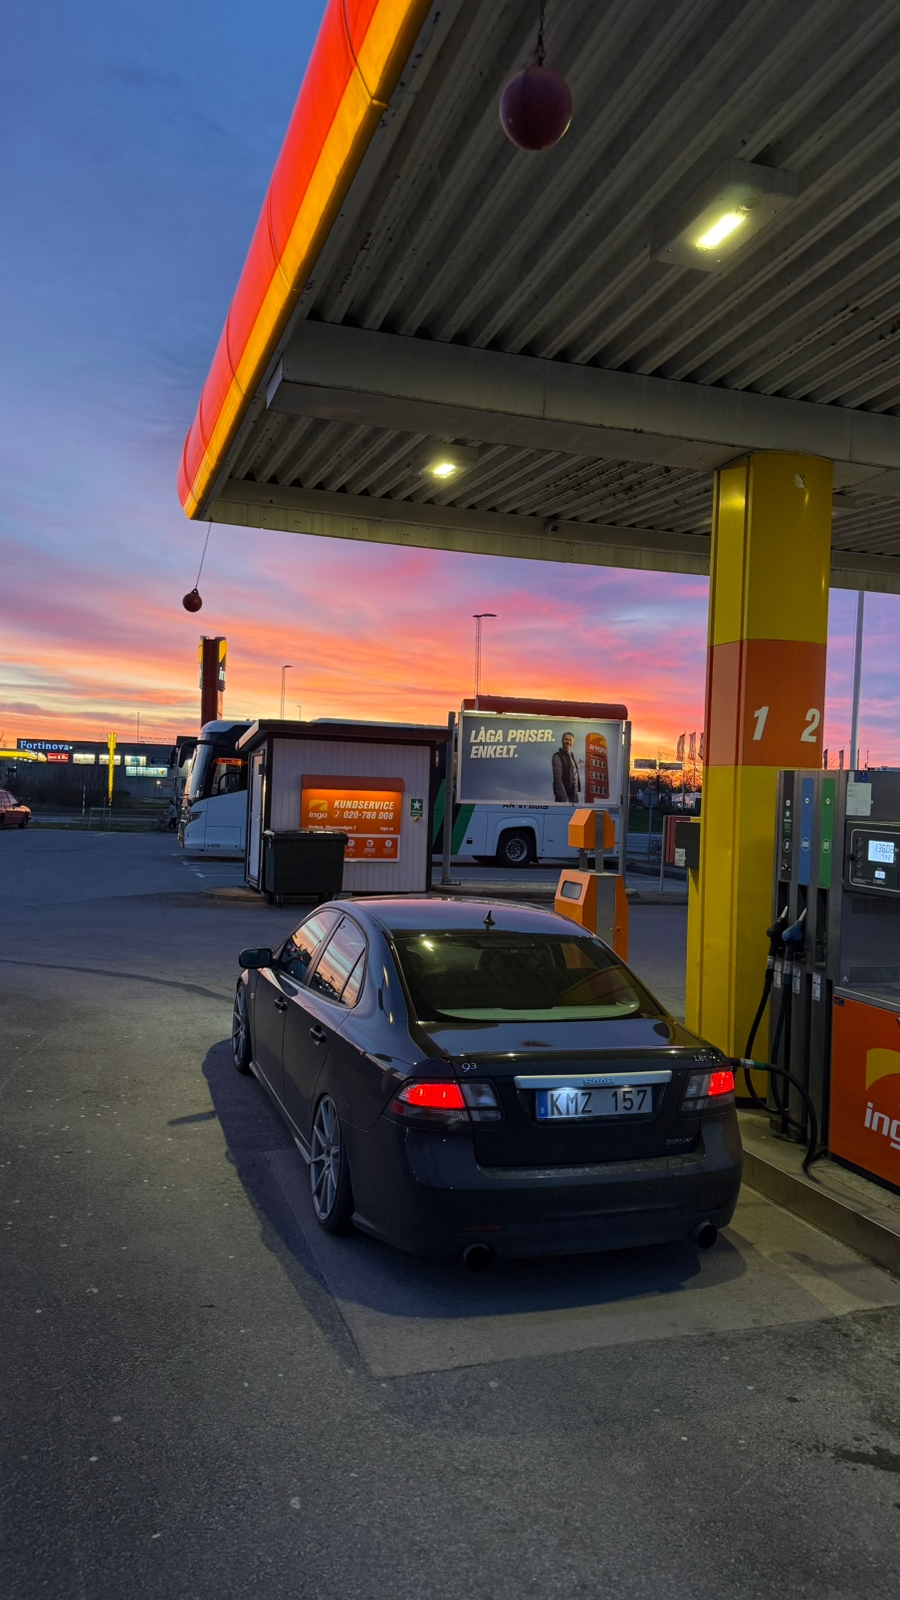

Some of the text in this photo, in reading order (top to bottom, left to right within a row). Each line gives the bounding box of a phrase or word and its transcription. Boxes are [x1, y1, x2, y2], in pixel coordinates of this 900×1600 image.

[753, 705, 770, 741] 1
[800, 707, 820, 743] 2
[470, 726, 556, 743] LÅGA PRISER.
[20, 740, 69, 751] Fortinova
[470, 745, 519, 759] ENKELT.
[333, 800, 395, 810] KUNDSERVICE
[308, 811, 328, 819] ingo
[343, 811, 394, 820] 020-788 008
[550, 1089, 648, 1117] KMZ 157
[863, 1101, 900, 1151] ing
